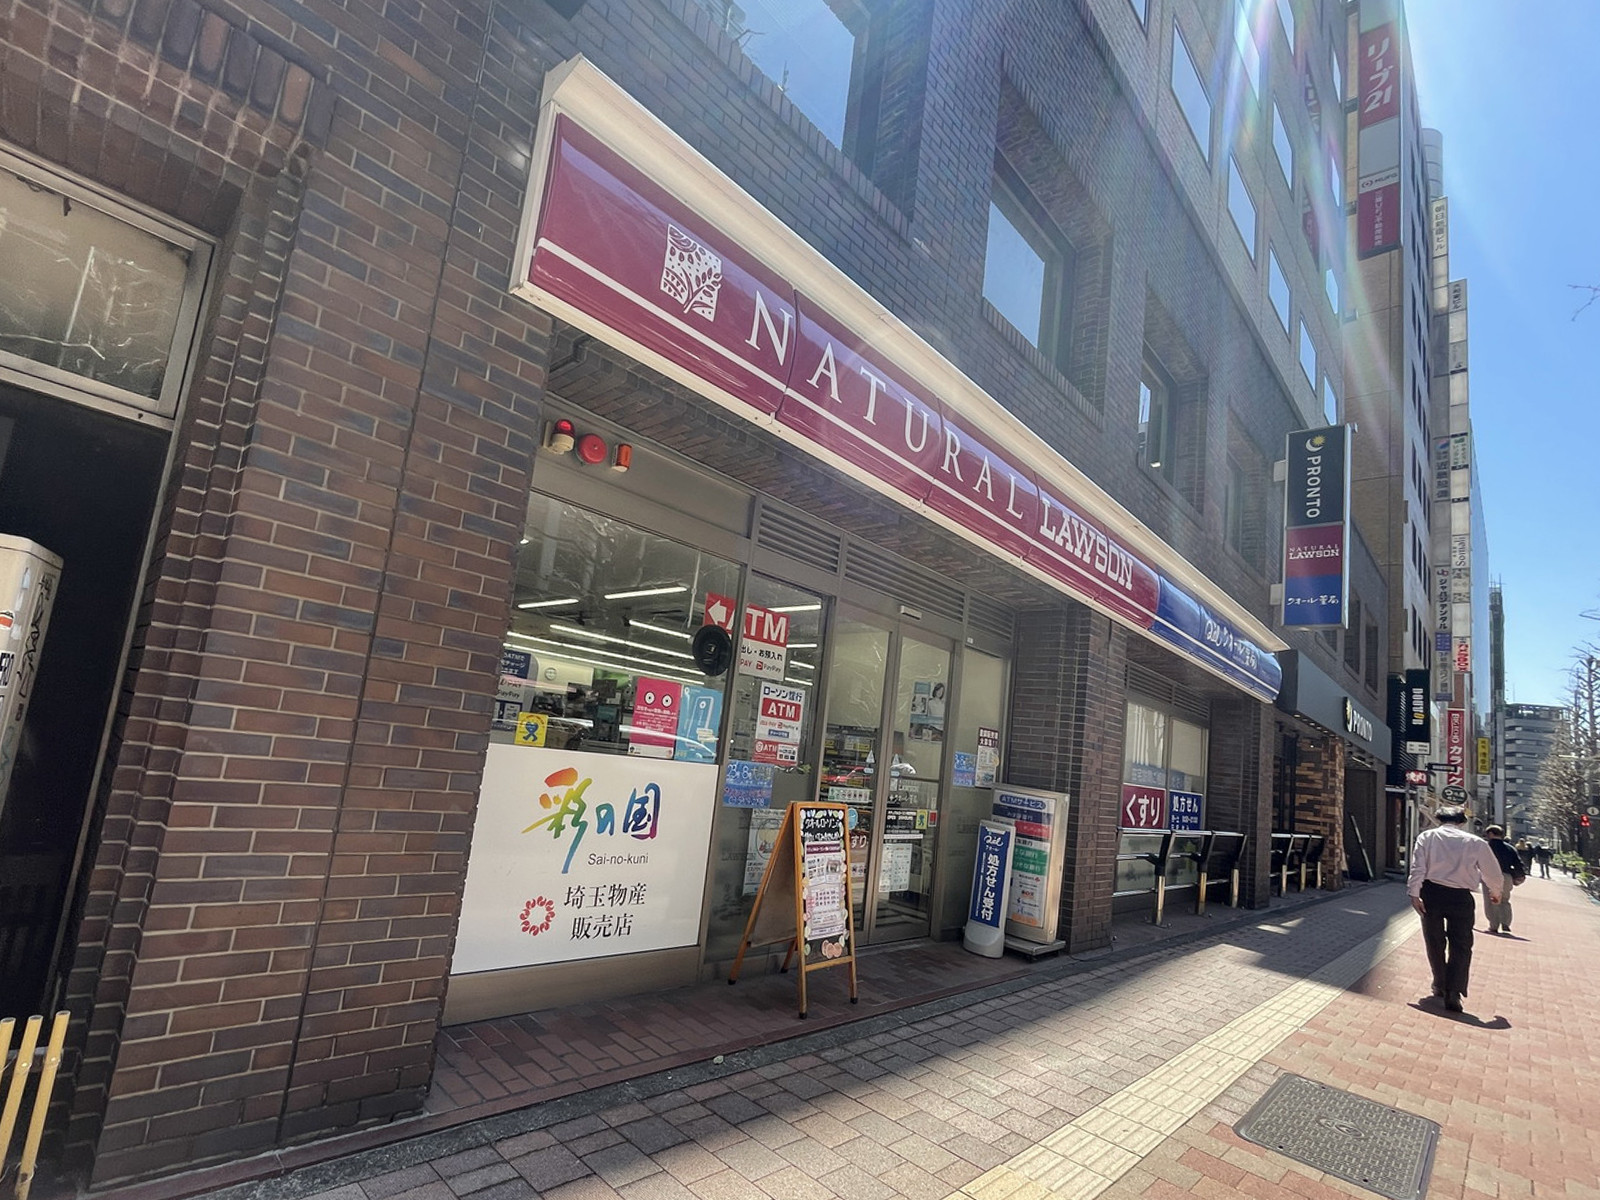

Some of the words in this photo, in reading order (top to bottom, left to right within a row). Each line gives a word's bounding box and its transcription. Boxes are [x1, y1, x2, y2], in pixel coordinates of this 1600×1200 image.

[745, 290, 1024, 520] NATURAL
[1038, 496, 1134, 592] LAWSON
[1305, 455, 1322, 519] PRONTO
[1289, 543, 1339, 552] NATURAL
[1289, 549, 1340, 561] LAWSON
[767, 701, 796, 719] ATM
[1125, 793, 1161, 827] くすり
[1172, 794, 1199, 813] 処方せん
[521, 767, 661, 875] 彩の国
[587, 852, 649, 867] Sai-no-kuni
[564, 882, 647, 910] 埼玉物産
[980, 853, 1000, 921] 処方せん受付
[570, 912, 634, 941] 販売店
